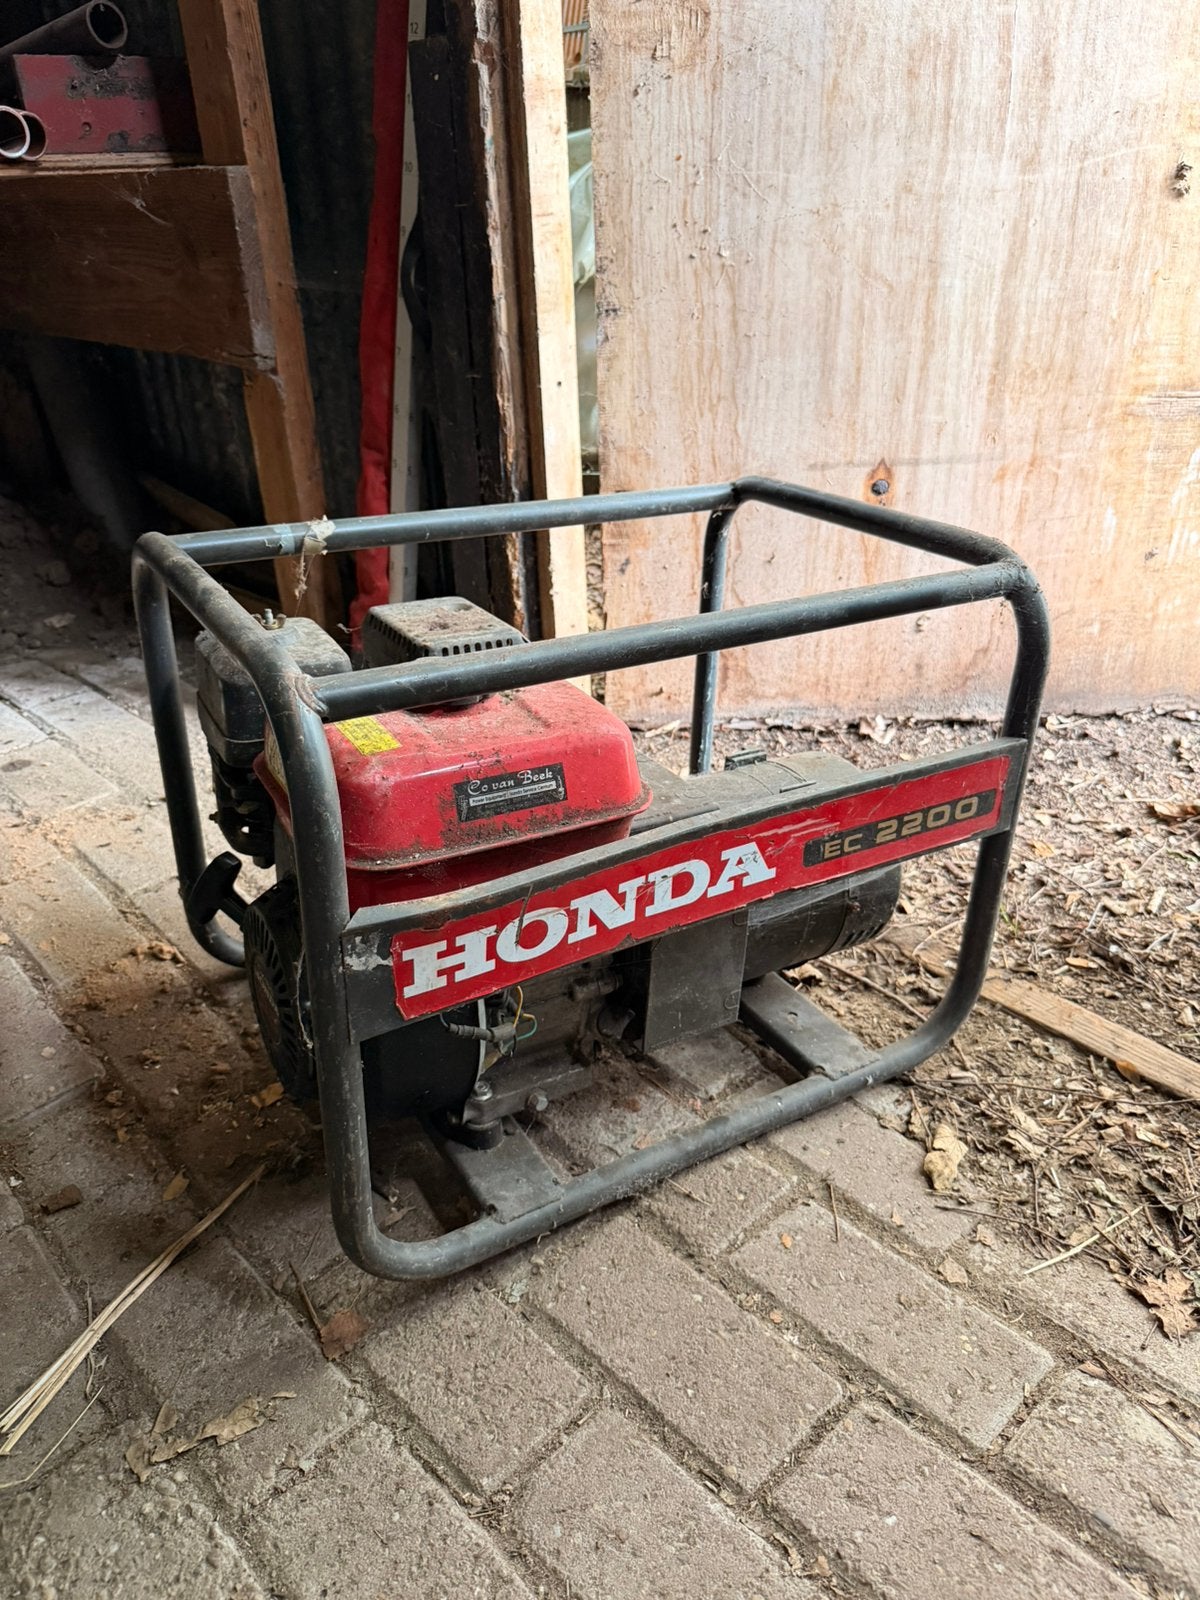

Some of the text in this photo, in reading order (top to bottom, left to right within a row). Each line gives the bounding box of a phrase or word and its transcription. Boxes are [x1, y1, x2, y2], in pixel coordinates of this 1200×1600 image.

[410, 22, 418, 34] 12
[405, 161, 413, 172] 10
[468, 768, 553, 795] Co van Beek
[824, 796, 979, 859] EC 2200
[402, 842, 776, 998] HONDA
